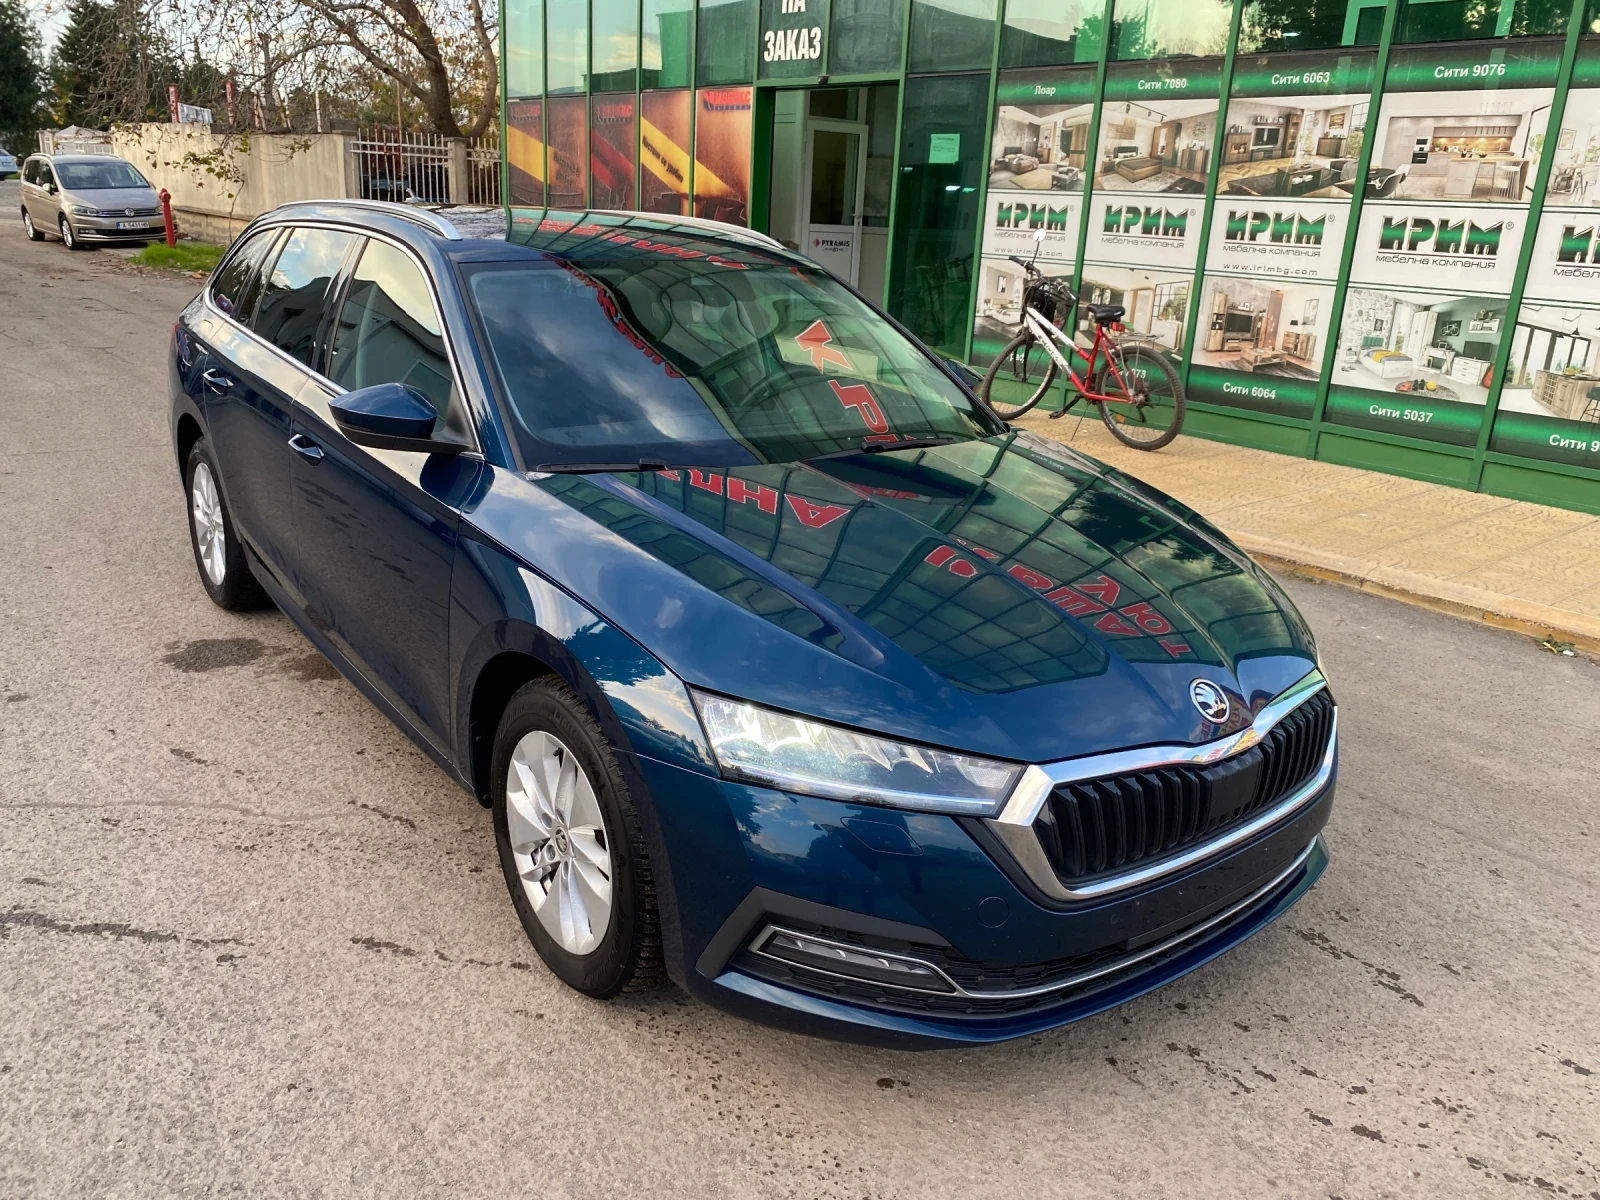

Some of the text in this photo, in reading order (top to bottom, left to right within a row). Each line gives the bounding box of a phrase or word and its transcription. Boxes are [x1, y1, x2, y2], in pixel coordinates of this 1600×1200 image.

[764, 27, 821, 62] ЗАКАЗ
[1272, 72, 1330, 85] Сити 6063
[1434, 64, 1506, 78] Сити 9076
[1034, 85, 1056, 96] Лоар
[1138, 78, 1187, 90] Сити 7080
[996, 202, 1068, 231] ИРИМ
[1102, 204, 1189, 237] ИРИМ
[1225, 210, 1326, 245] ИРИМ
[1101, 236, 1184, 248] мебелна компания
[1378, 216, 1504, 255] ИРИМ
[1223, 245, 1320, 258] мебелна компания
[1223, 263, 1318, 276] www.irimbg.com
[1376, 255, 1496, 269] мебелна компания
[1222, 382, 1276, 400] Сити 6064
[1369, 404, 1434, 424] Сити 5037
[1549, 434, 1587, 450] Сити
